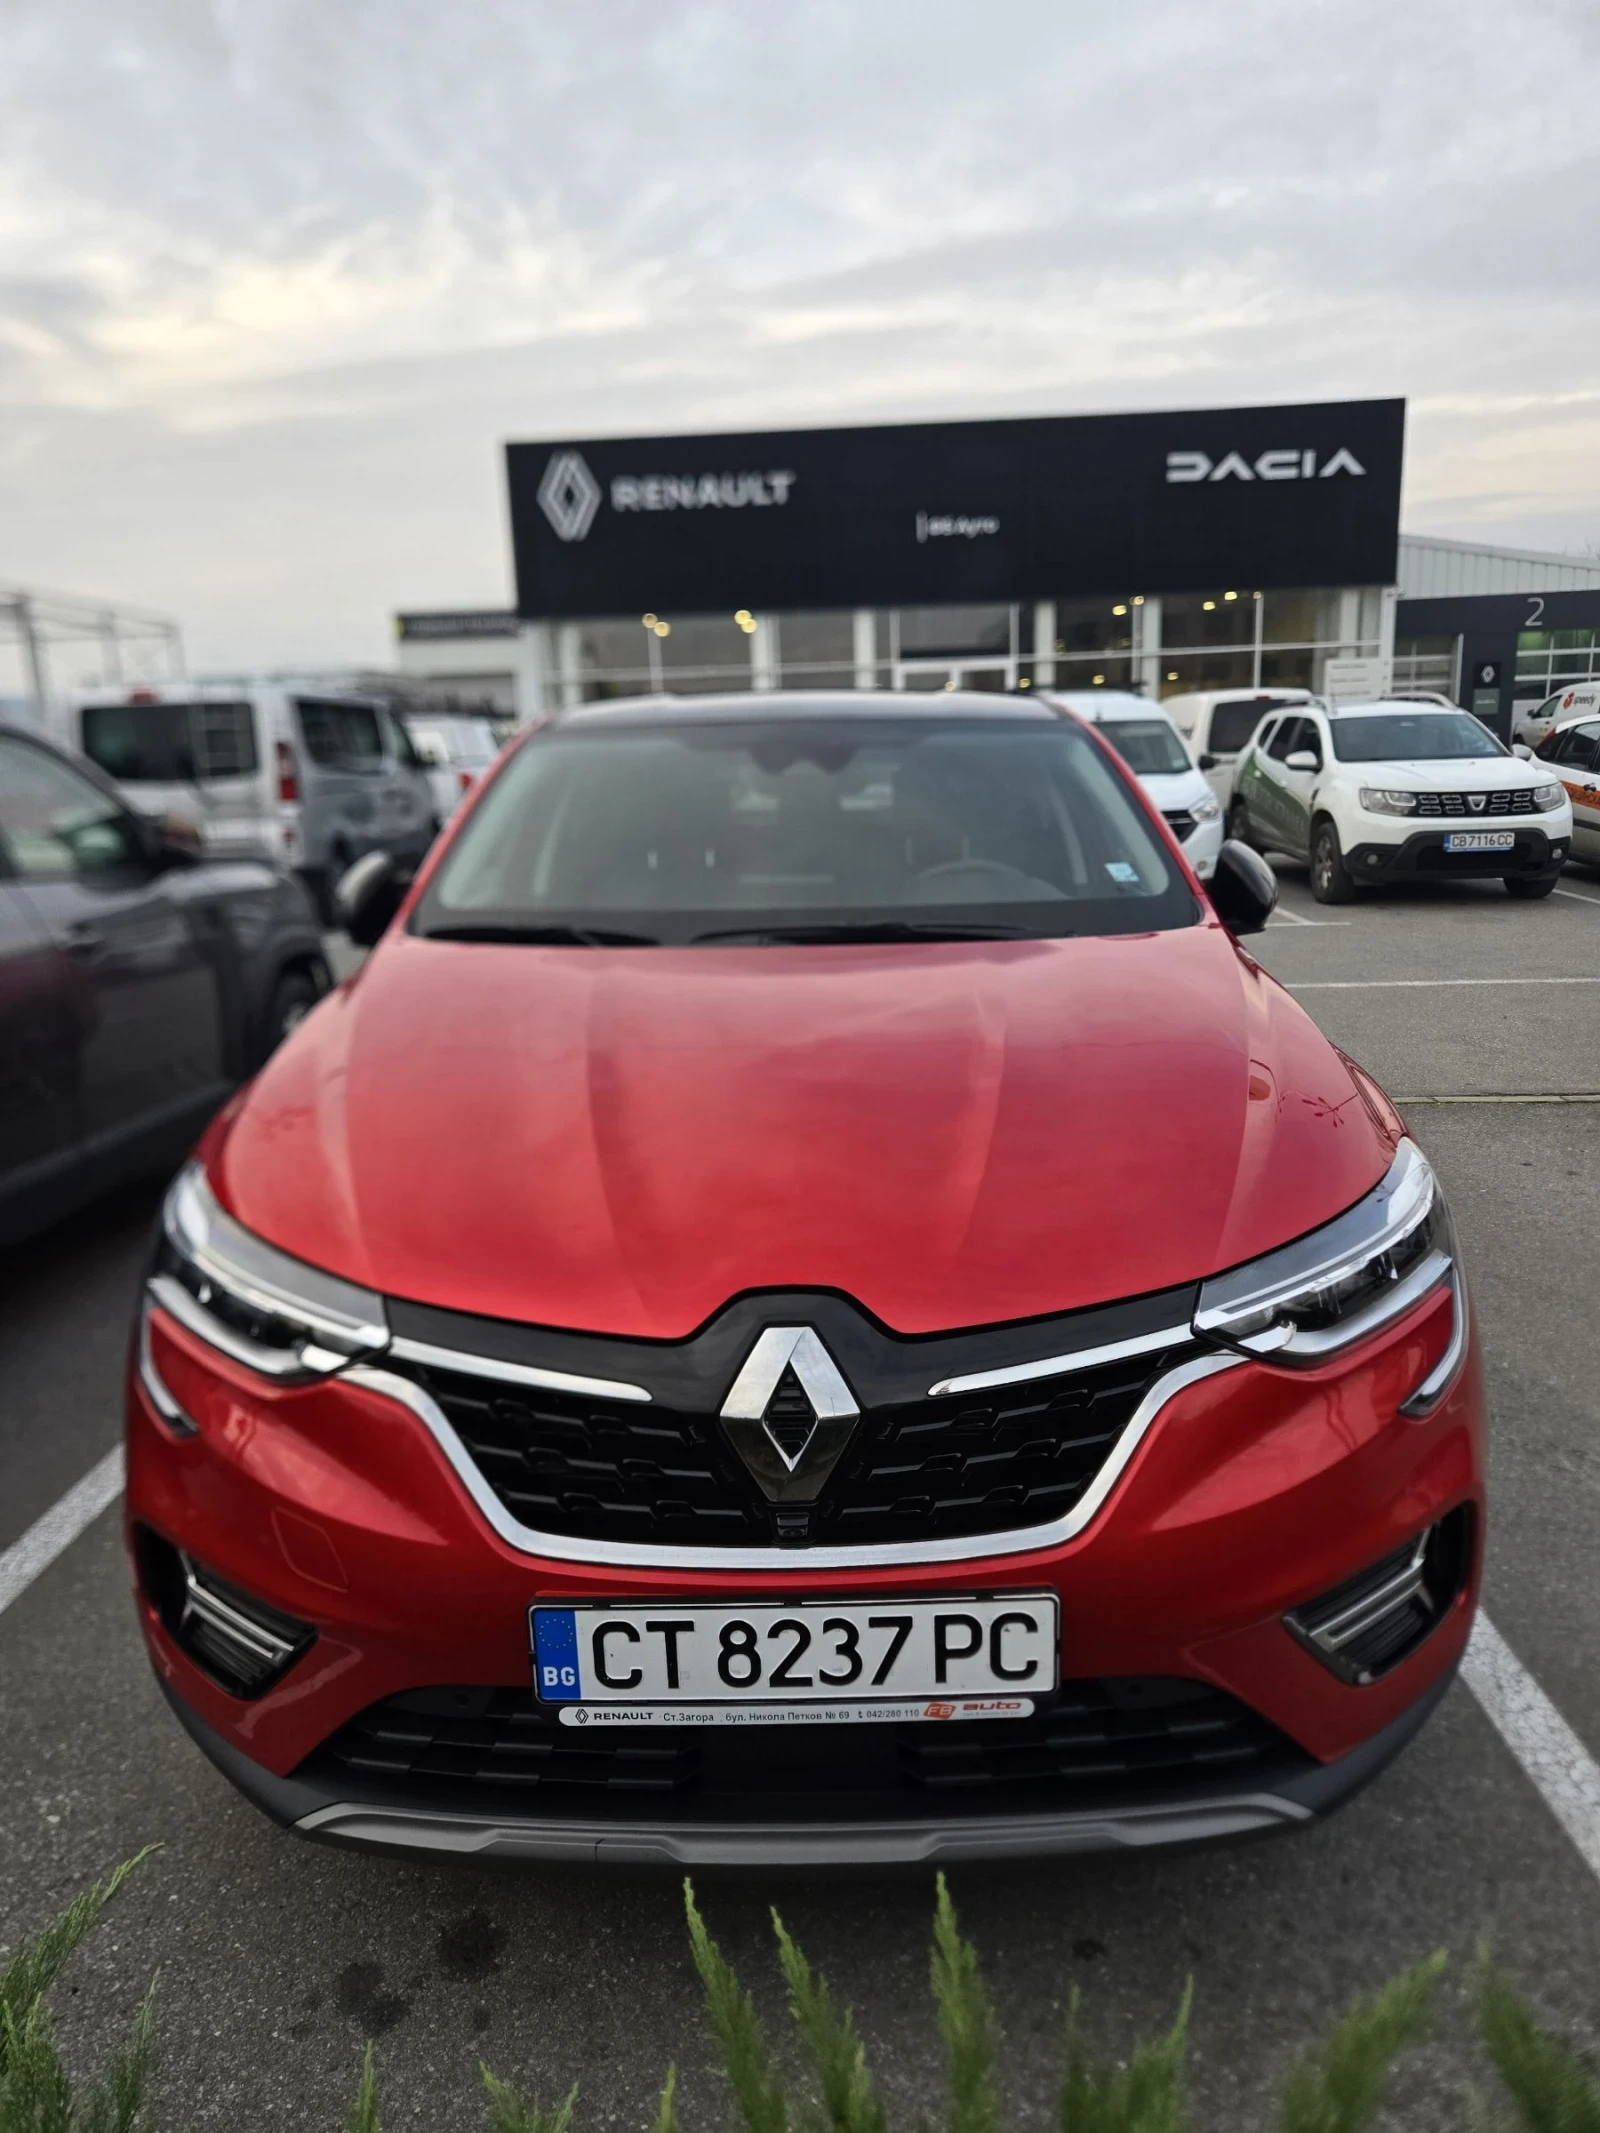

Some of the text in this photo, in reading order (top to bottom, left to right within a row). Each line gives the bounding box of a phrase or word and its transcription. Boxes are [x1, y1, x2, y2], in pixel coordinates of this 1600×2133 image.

[1166, 447, 1367, 483] DACIA
[610, 469, 796, 512] RENAULT
[1524, 597, 1545, 627] 2
[1452, 835, 1467, 847] CB
[1468, 834, 1496, 847] 7116
[1497, 834, 1513, 846] CC
[592, 1611, 1039, 1690] CT 8237 PC
[543, 1666, 576, 1687] BG
[593, 1711, 654, 1721] RENAULT
[725, 1712, 747, 1723] бул.
[750, 1712, 785, 1721] Никола
[787, 1711, 822, 1721] Петков
[838, 1710, 850, 1720] 69
[866, 1708, 901, 1719] 042/280
[904, 1708, 920, 1718] 110
[963, 1700, 1022, 1711] auto
